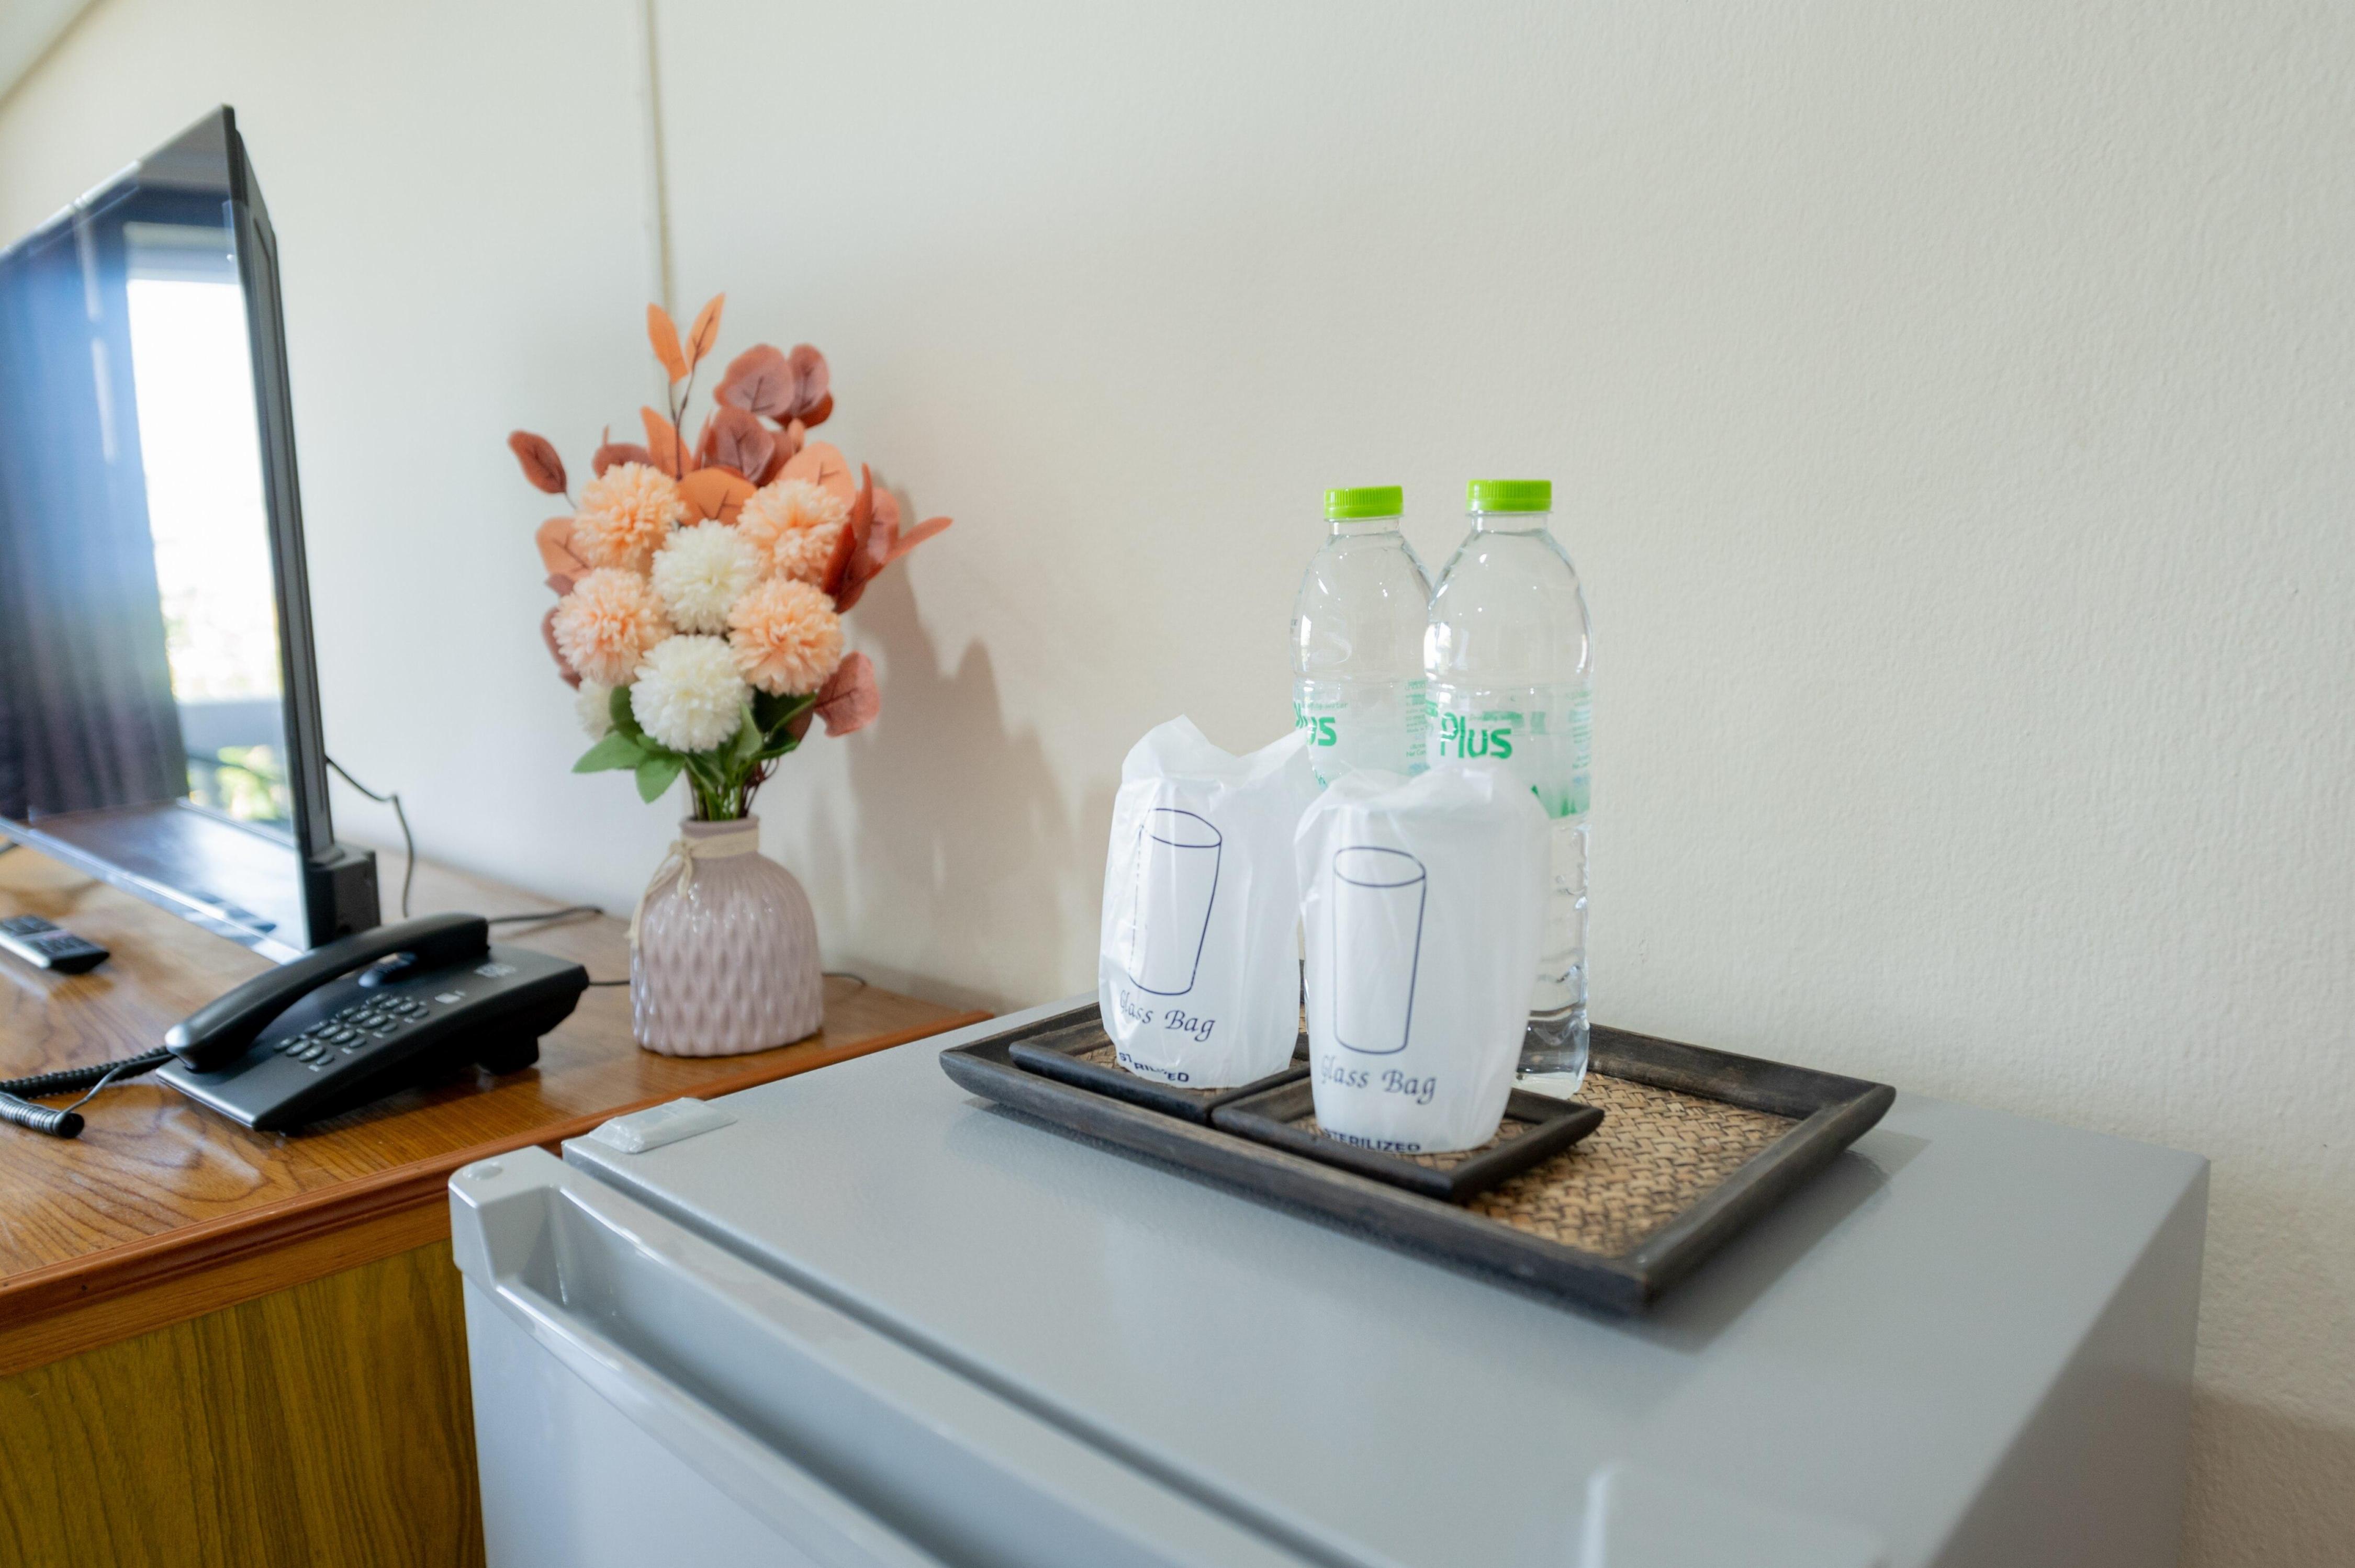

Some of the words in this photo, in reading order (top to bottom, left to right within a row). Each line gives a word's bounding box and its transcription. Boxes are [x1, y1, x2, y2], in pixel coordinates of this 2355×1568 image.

[1440, 712, 1512, 759] Plus
[1120, 989, 1153, 1023] Glass
[1164, 1010, 1216, 1042] Bag
[1321, 1055, 1370, 1089] Glass
[1382, 1069, 1437, 1105] Bag
